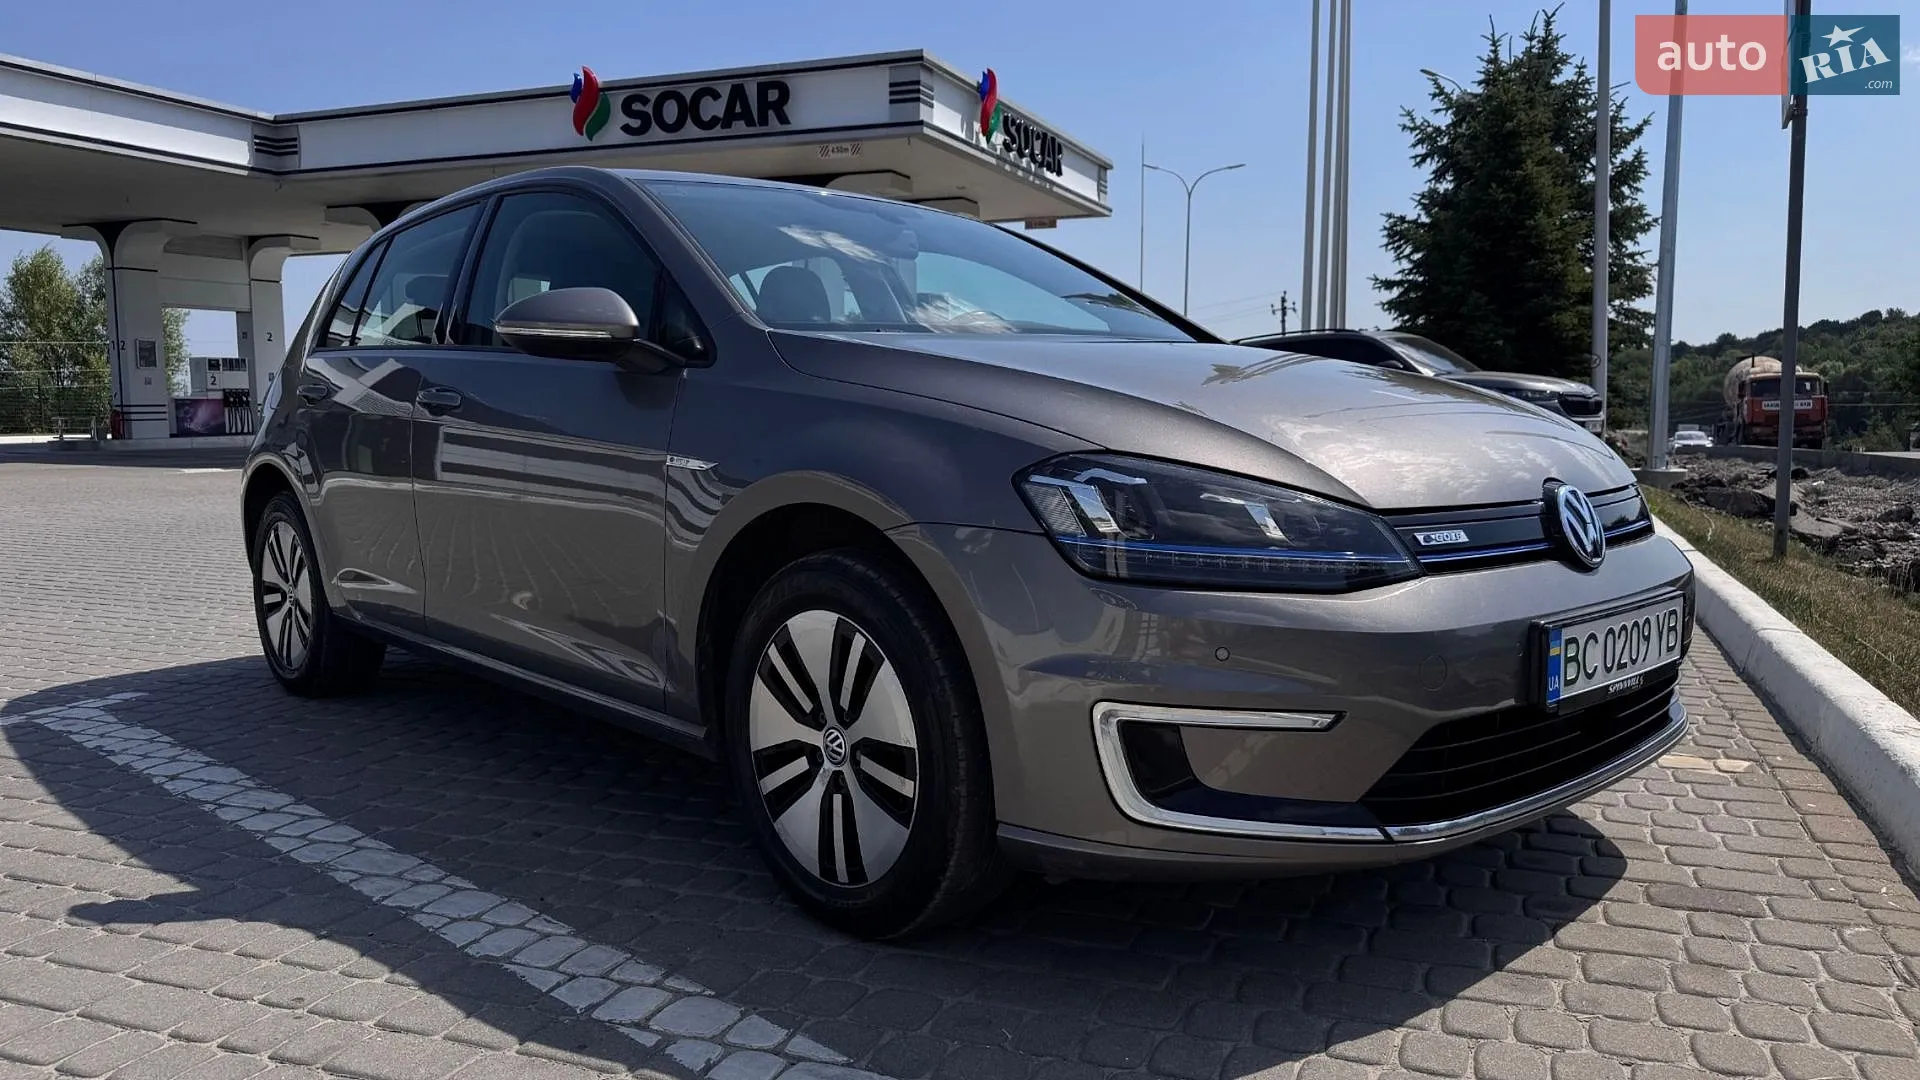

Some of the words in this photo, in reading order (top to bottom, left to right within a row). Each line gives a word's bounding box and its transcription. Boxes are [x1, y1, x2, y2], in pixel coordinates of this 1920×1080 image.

[620, 80, 791, 136] SOCAR
[1002, 112, 1063, 177] SOCAR
[266, 332, 273, 342] 2
[120, 340, 126, 351] 2
[210, 375, 217, 386] 2
[1563, 630, 1599, 688] BC
[1603, 616, 1652, 674] 0209
[1656, 608, 1678, 659] YB
[1548, 676, 1560, 691] UA
